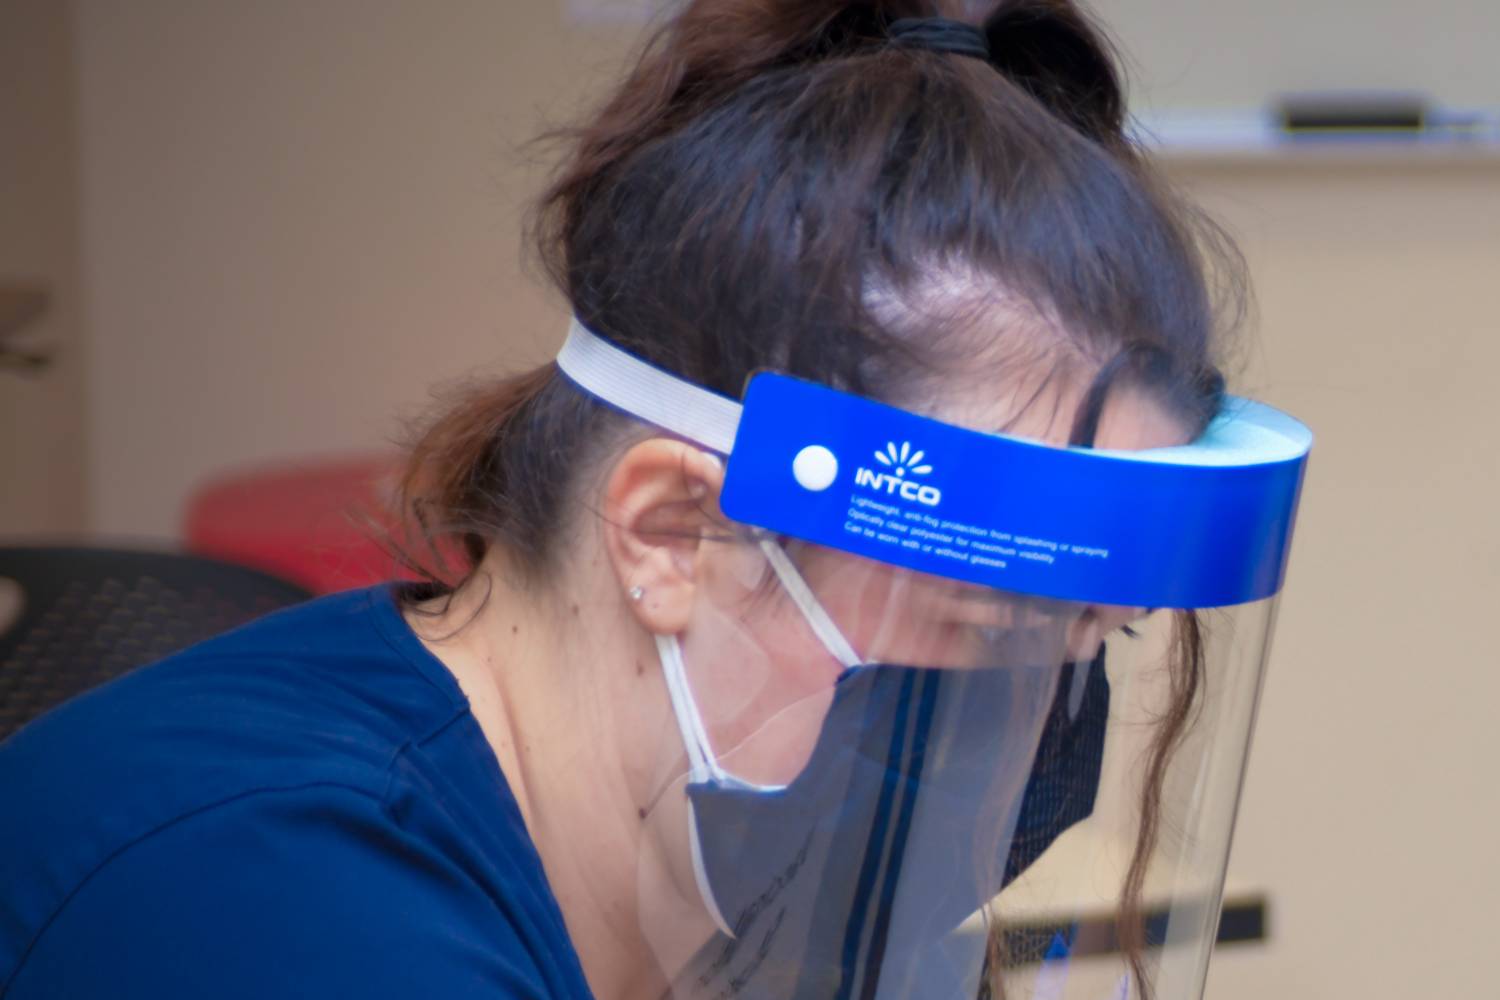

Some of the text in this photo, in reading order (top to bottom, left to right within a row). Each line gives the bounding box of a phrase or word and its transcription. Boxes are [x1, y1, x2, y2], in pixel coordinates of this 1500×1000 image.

[855, 467, 941, 507] INTCO
[844, 520, 862, 534] Can
[863, 528, 876, 538] be
[877, 533, 899, 544] worn
[901, 539, 920, 549] with
[935, 547, 969, 561] without
[970, 555, 1007, 568] glasses
[847, 507, 1055, 564] Optically clear polyester for maximum visibility
[940, 520, 988, 537] protection
[990, 529, 1011, 541] from
[1014, 535, 1057, 551] splashing
[1059, 543, 1069, 551] or
[1071, 545, 1109, 559] spraying
